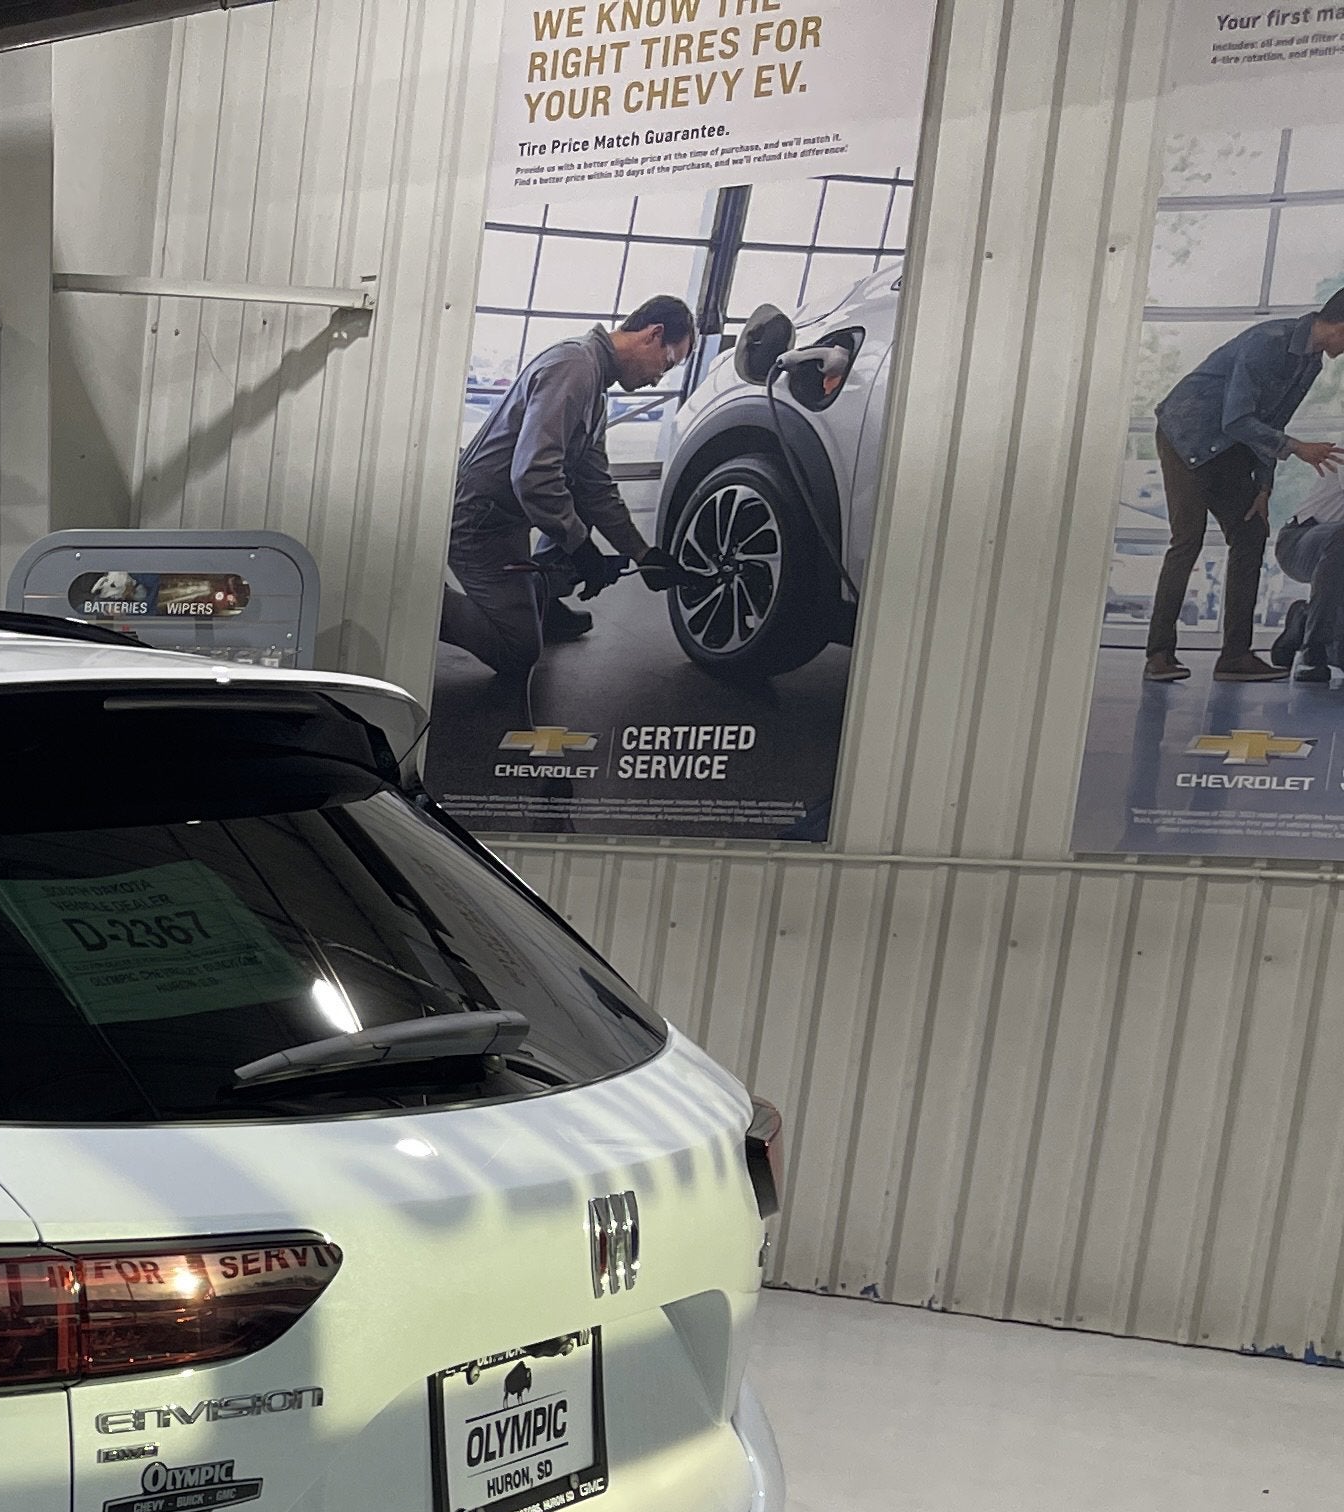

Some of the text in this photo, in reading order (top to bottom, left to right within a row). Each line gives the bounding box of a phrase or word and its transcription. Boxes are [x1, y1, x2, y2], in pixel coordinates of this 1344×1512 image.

[533, 6, 586, 41] WE
[596, 0, 701, 34] KNOW
[1217, 14, 1261, 31] Your
[1266, 7, 1312, 27] first
[527, 16, 822, 83] RIGHT TIRES FOR
[524, 60, 807, 124] YOUR CHEVY EV.
[518, 124, 730, 157] Tire Price Match Guarantee.
[83, 600, 213, 615] BATTERIES WIPERS
[621, 725, 757, 751] CERTIFIED
[494, 763, 599, 779] CHEVROLET
[617, 754, 728, 780] SERVICE
[1175, 772, 1315, 791] CHEVROLET
[63, 909, 211, 951] D-2367
[95, 1385, 324, 1435] ENVISION
[466, 1399, 568, 1468] OLYMPIC
[142, 1461, 234, 1493] OLYMPIC
[487, 1459, 553, 1498] HURON, SD
[579, 1477, 605, 1497] GMC
[176, 1495, 205, 1508] BUICK
[215, 1487, 237, 1500] GMC
